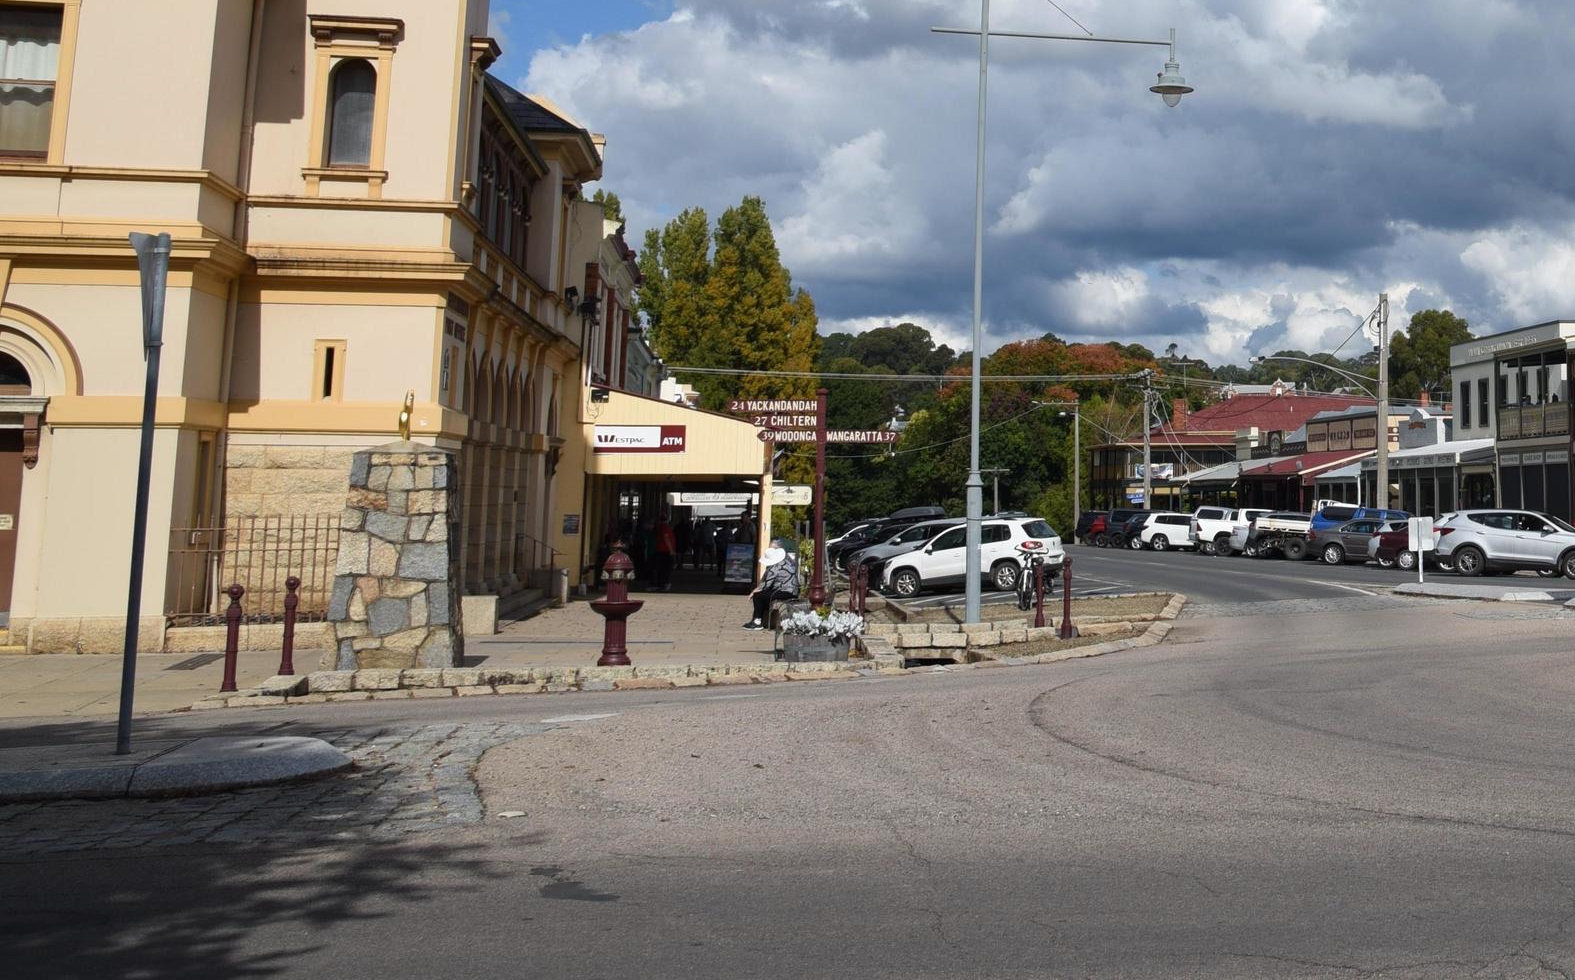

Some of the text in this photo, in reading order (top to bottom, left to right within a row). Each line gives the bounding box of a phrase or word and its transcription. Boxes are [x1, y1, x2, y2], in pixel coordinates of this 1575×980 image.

[731, 401, 817, 411] 24 YACKANDANDAH
[754, 416, 817, 426] 27 CHILTERN
[662, 436, 683, 446] ATM
[762, 431, 817, 441] 39 WODONGA
[826, 431, 896, 442] WANGARATTA 37
